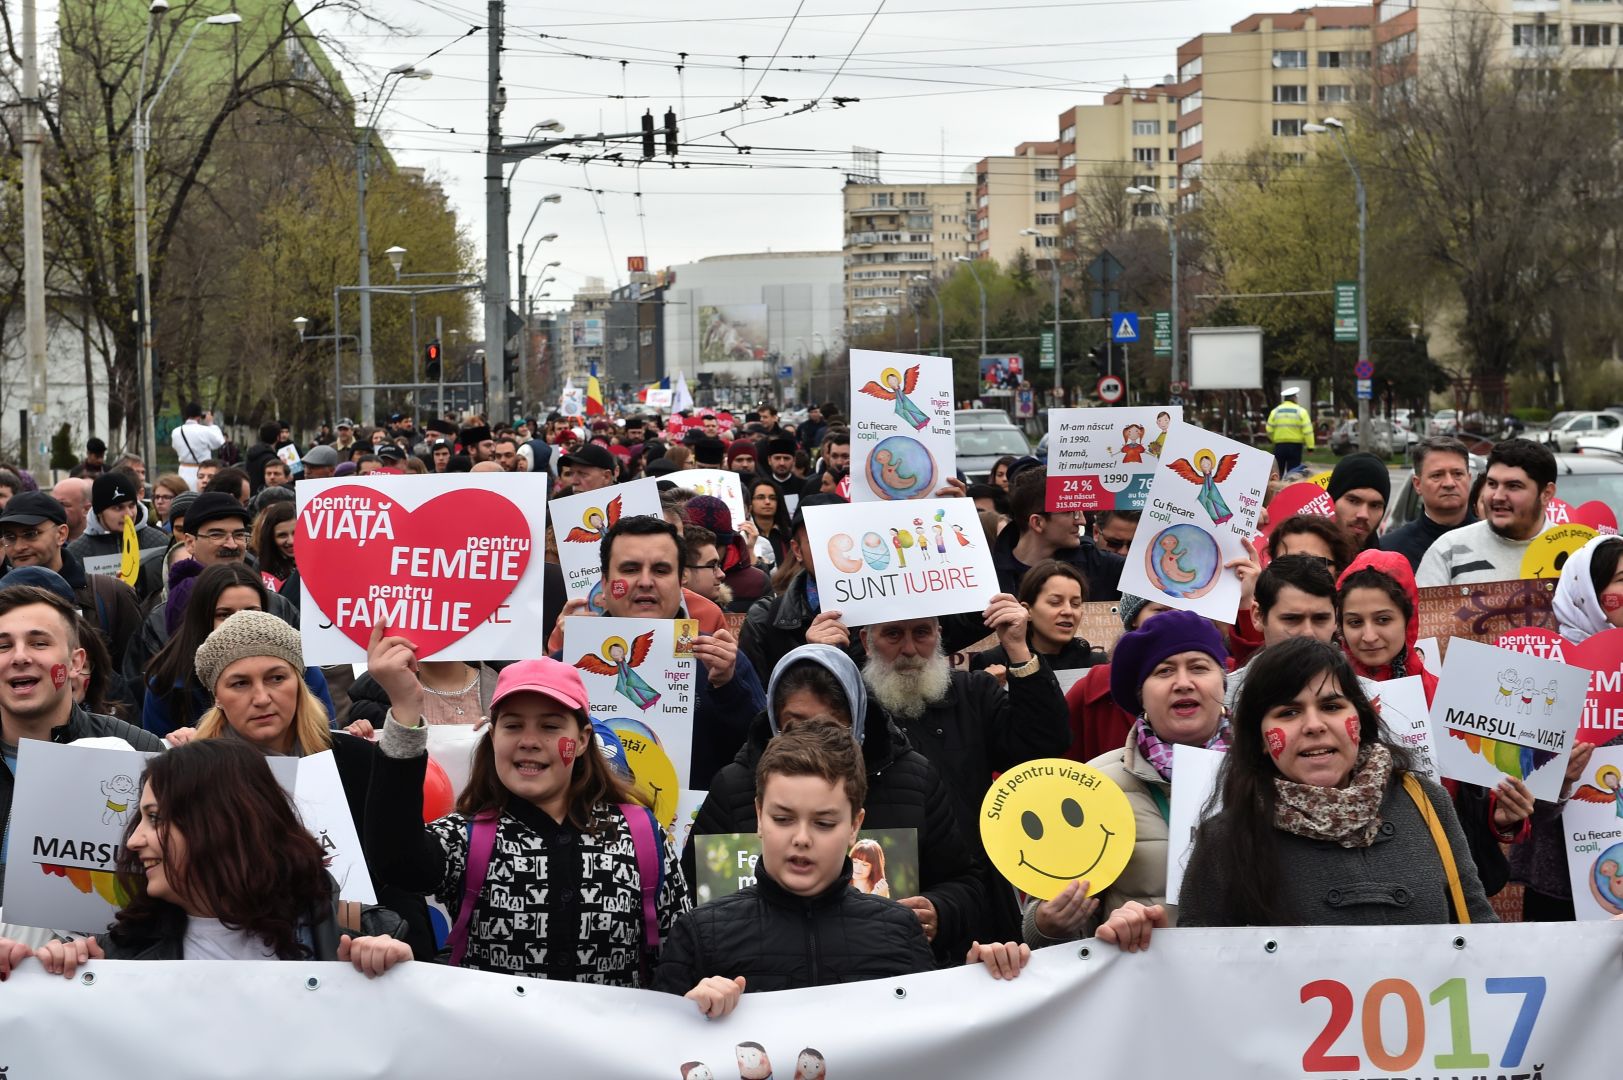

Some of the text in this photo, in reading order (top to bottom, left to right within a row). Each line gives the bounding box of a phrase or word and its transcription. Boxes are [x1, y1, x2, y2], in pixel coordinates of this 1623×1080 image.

[930, 397, 950, 409] înger
[934, 407, 950, 417] vine
[857, 421, 898, 431] Cu fiecare
[931, 426, 951, 436] lume
[1059, 422, 1114, 432] M-am născut
[857, 432, 880, 441] copil,
[1070, 435, 1091, 443] 1990.
[1058, 449, 1088, 458] Mamă,
[1068, 460, 1117, 471] mulțumesc!
[1103, 473, 1129, 484] 1990
[1062, 480, 1093, 492] 24 %
[1250, 486, 1261, 497] un
[312, 494, 371, 513] pentru
[1082, 501, 1099, 509] copii
[1239, 493, 1259, 508] înger
[1153, 498, 1195, 520] Cu fiecare
[1239, 504, 1256, 518] vine
[1149, 510, 1172, 525] copil,
[1245, 517, 1253, 529] în
[303, 501, 395, 547] VIAȚĂ
[1230, 523, 1251, 539] lume
[1544, 529, 1594, 544] Sunt pent
[466, 535, 530, 553] pentru
[390, 546, 521, 581] FEMEIE
[568, 566, 601, 579] Cu fieca
[571, 577, 593, 589] copil,
[834, 566, 979, 603] SUNT IUBIRE
[368, 584, 433, 602] pentru
[336, 597, 472, 632] FAMILIE
[1499, 633, 1546, 648] pentru
[677, 660, 691, 669] un
[664, 669, 691, 682] înger
[667, 681, 690, 691] vine
[678, 692, 689, 703] în
[662, 703, 689, 714] lume
[1411, 719, 1425, 729] un
[1445, 707, 1517, 738] MARȘUL
[1537, 728, 1567, 751] VIAȚĂ
[1401, 733, 1427, 745] înger
[987, 765, 1102, 821] Sunt pentru viață!
[1573, 830, 1622, 842] Cu fiecare
[1574, 842, 1601, 853] copil,
[1299, 976, 1547, 1073] 2017
